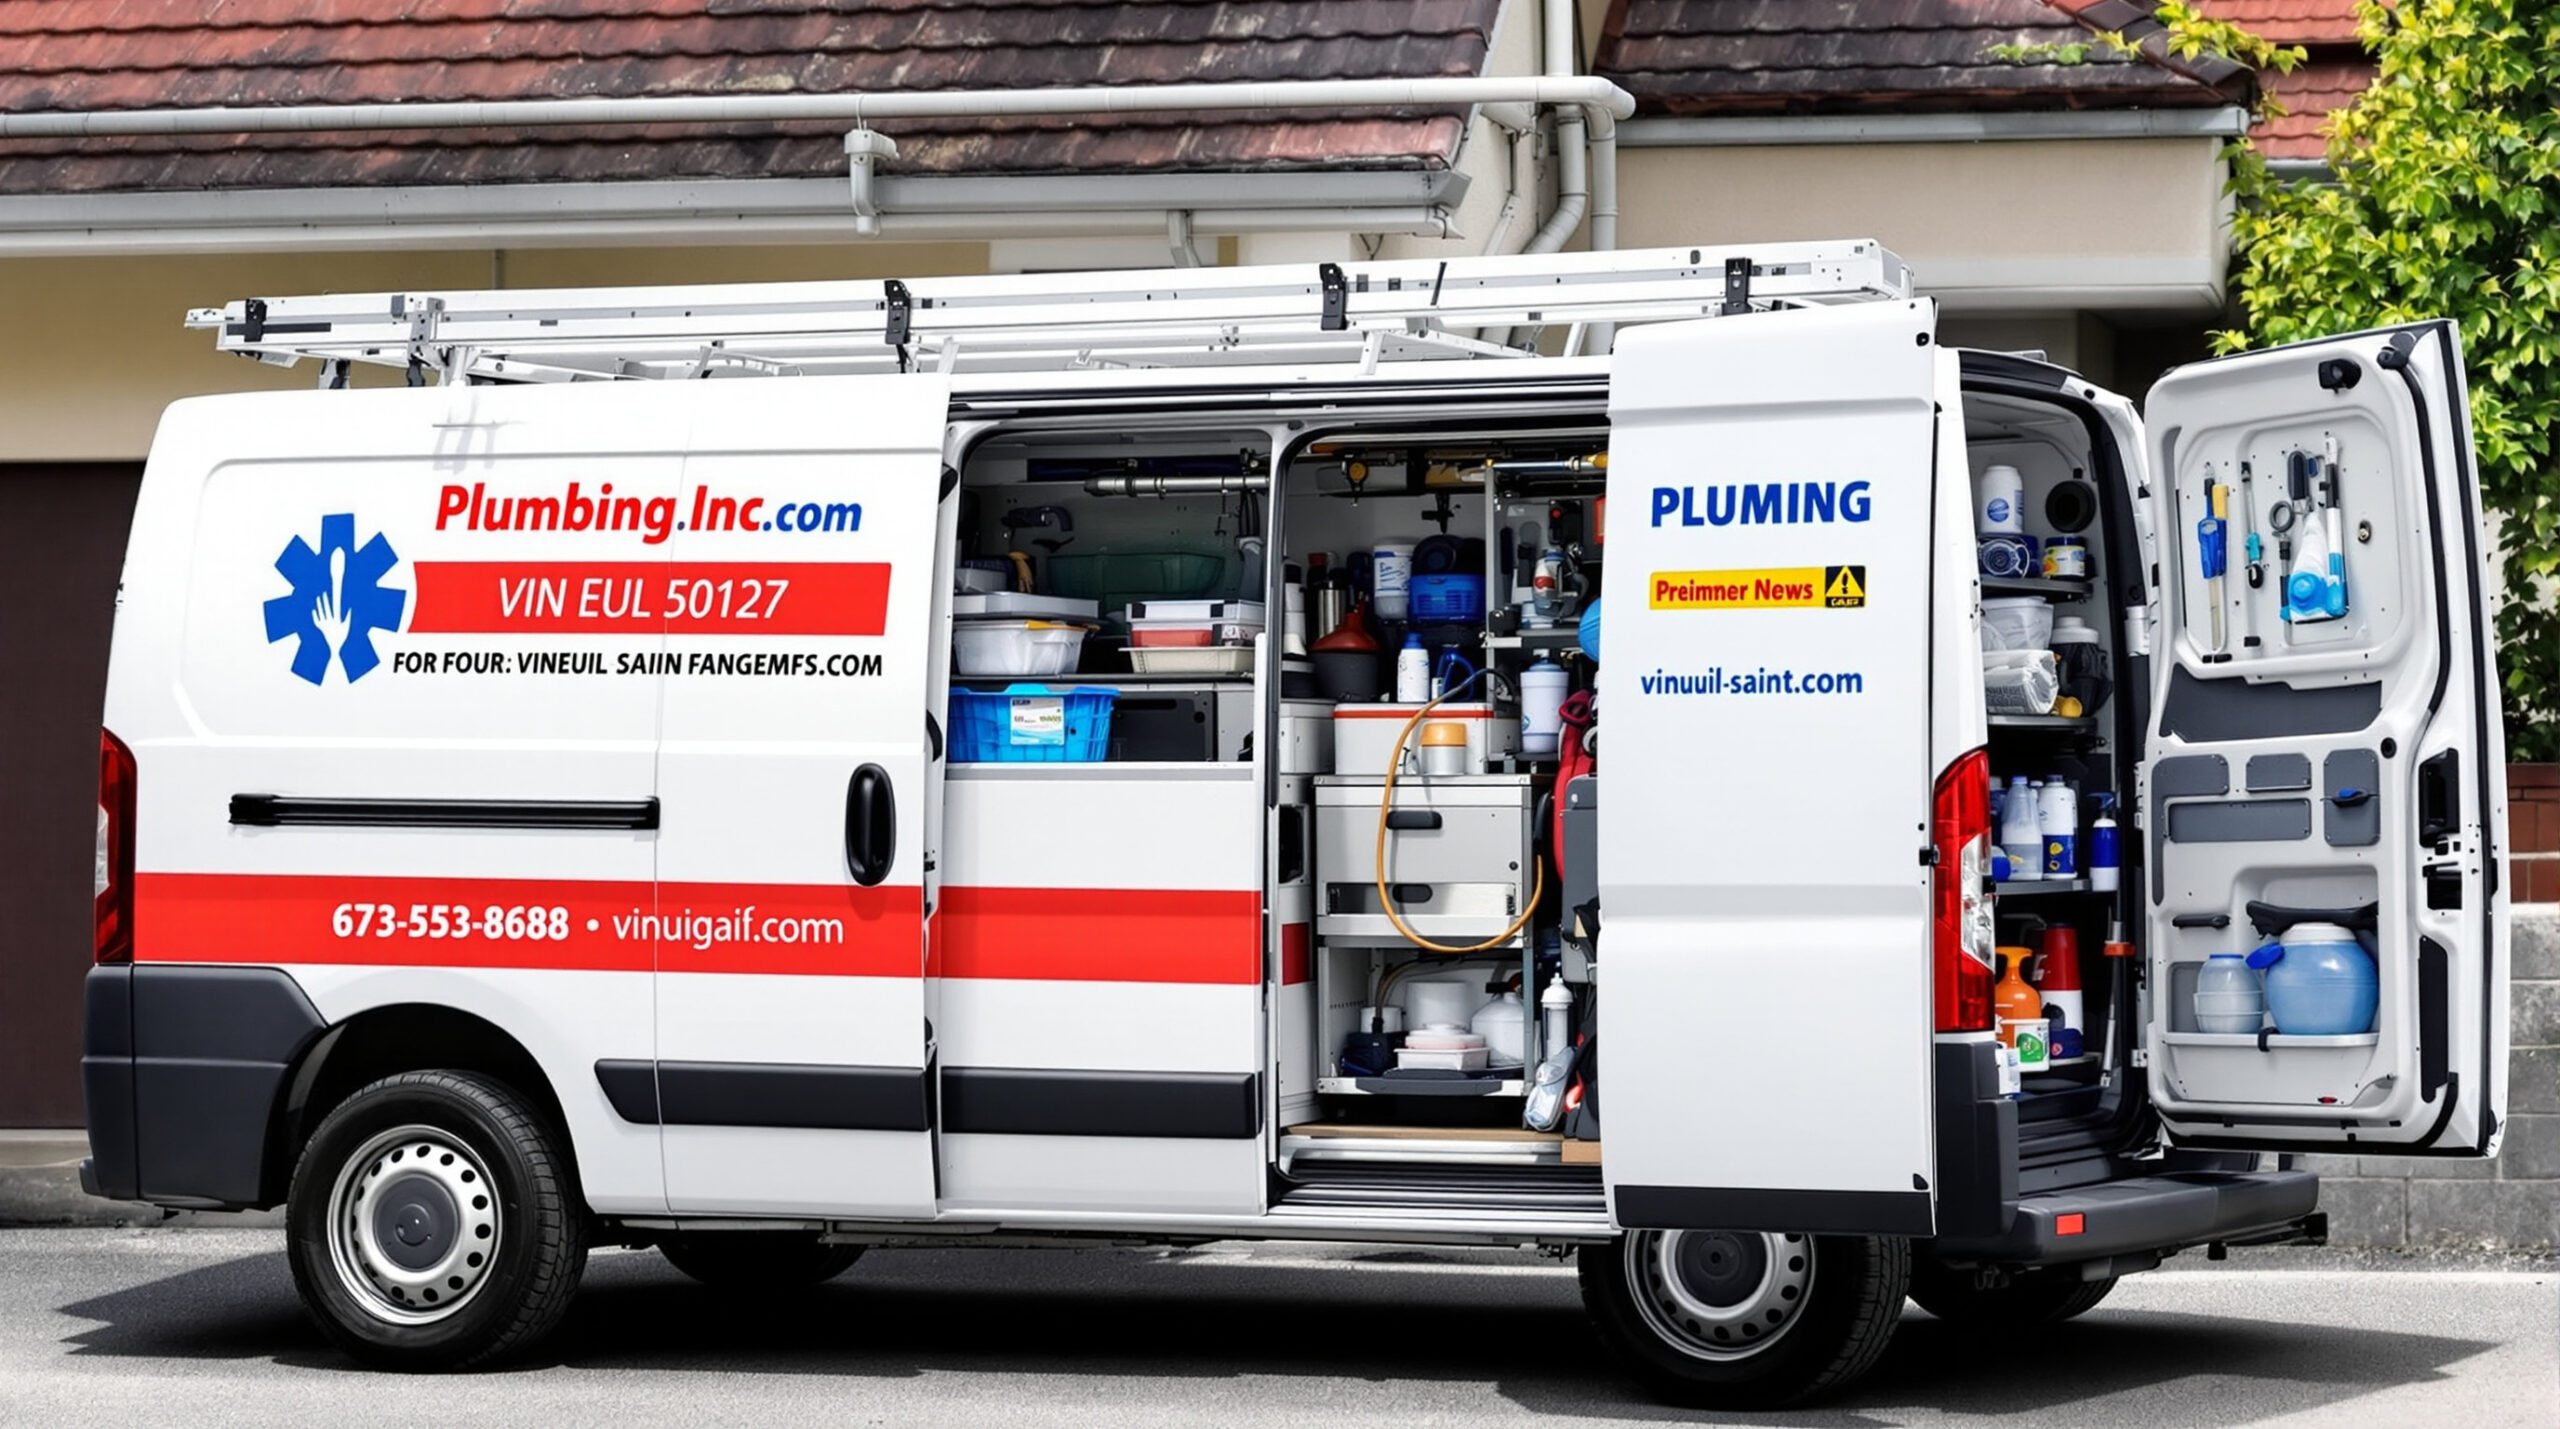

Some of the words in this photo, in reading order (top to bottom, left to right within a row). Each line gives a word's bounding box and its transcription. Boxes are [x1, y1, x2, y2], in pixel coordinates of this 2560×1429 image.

[435, 481, 863, 545] Plumbing.Inc.com
[1651, 480, 1871, 528] PLUMING
[499, 577, 568, 618] VIN
[578, 577, 651, 618] EUL
[663, 578, 789, 619] 50127
[1754, 578, 1814, 601] News
[393, 651, 437, 674] FOR
[442, 651, 512, 675] FOUR:
[517, 652, 608, 676] VINEUIL
[688, 653, 882, 677] FANGEMFS.COM
[1640, 667, 1863, 694] vinuuil-saint.com
[332, 903, 569, 941] 673-553-8688
